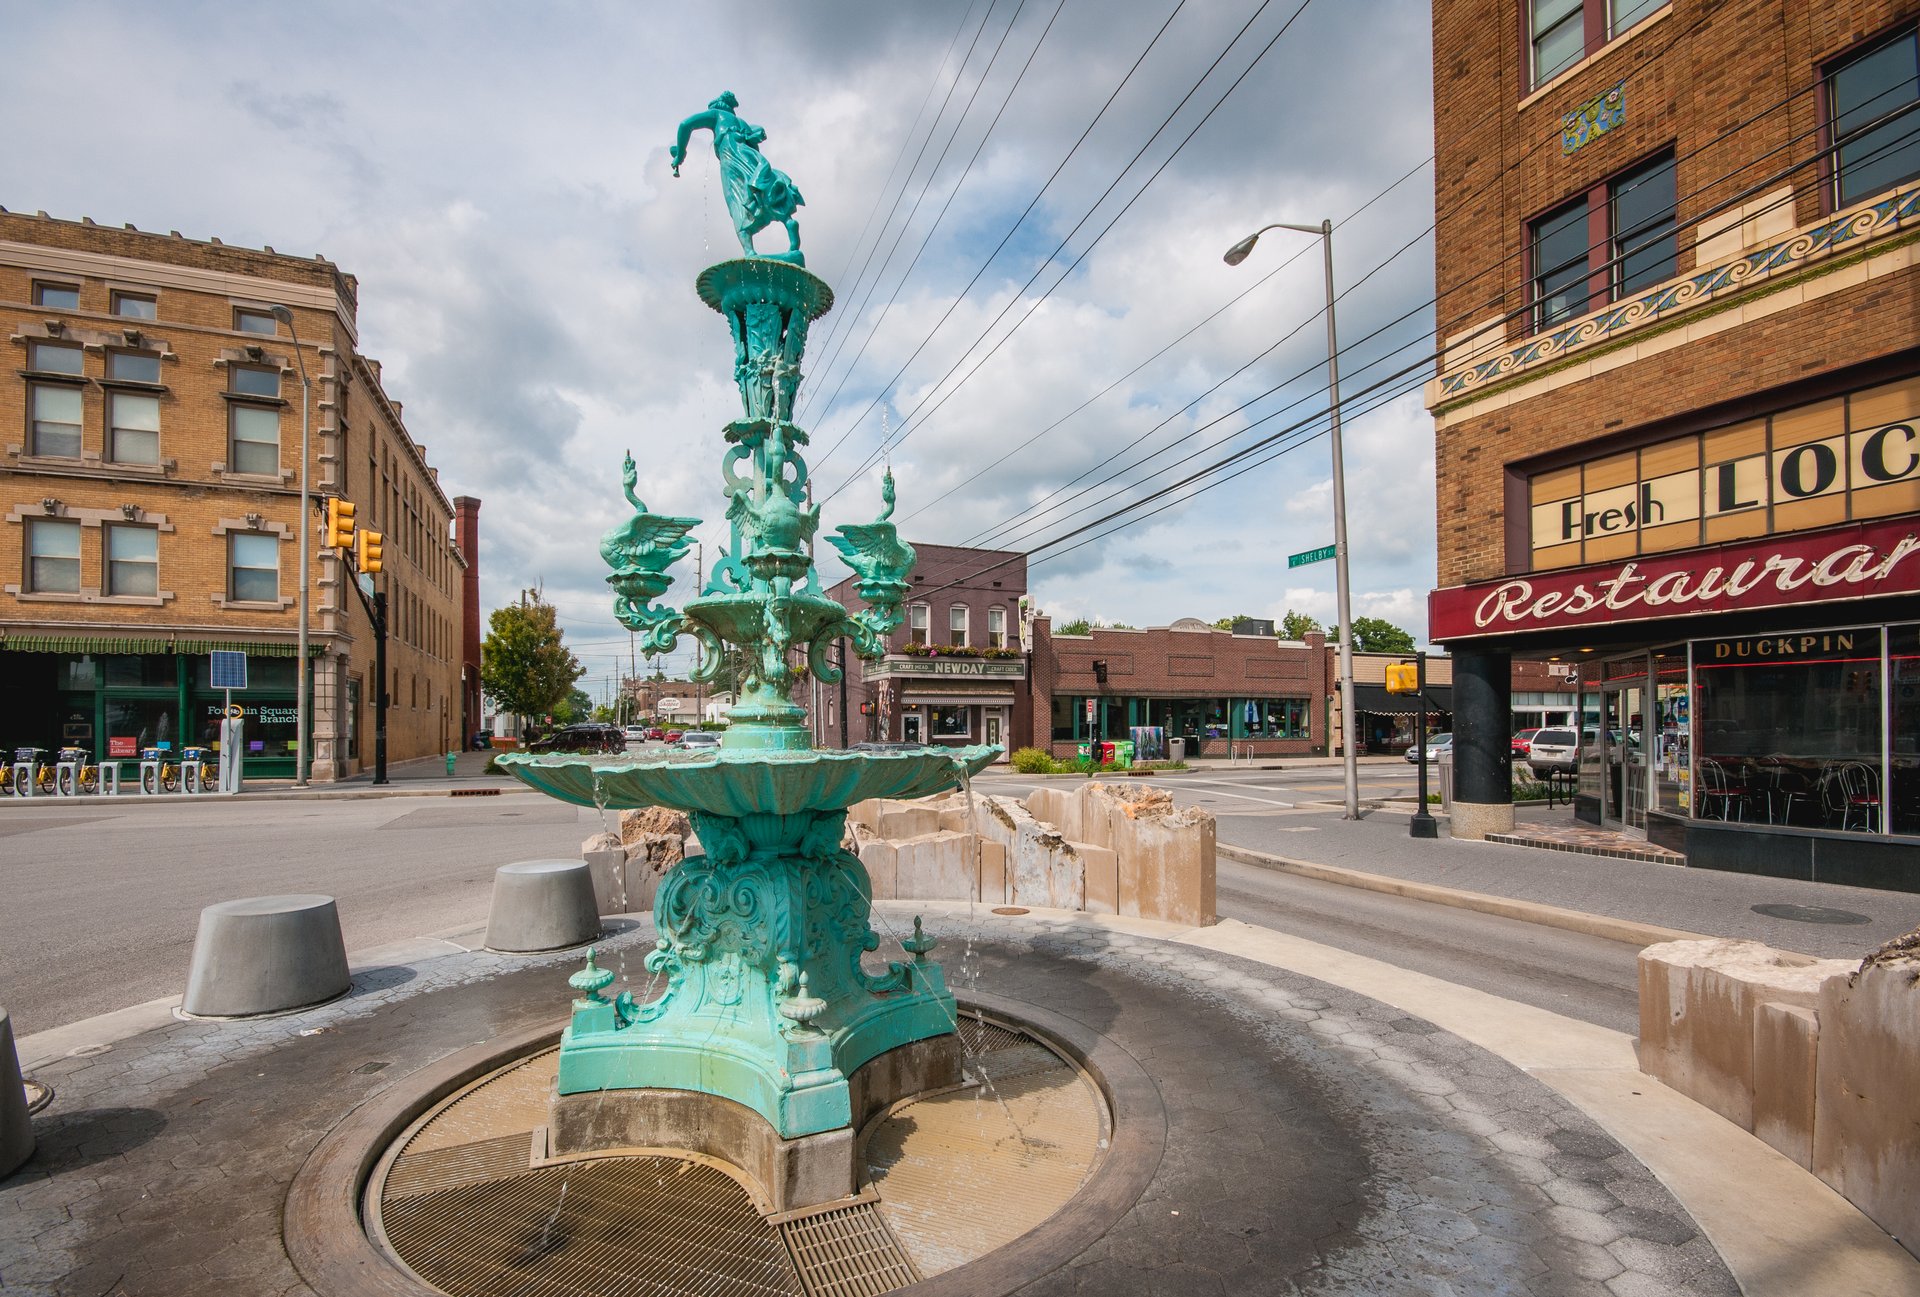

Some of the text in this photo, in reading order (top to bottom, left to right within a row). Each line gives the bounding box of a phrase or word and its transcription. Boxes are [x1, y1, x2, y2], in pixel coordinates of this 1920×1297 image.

[1562, 424, 1920, 540] Fresh LOC
[1301, 549, 1327, 564] SHELBY
[1715, 633, 1854, 658] DUCKPIN
[934, 662, 985, 674] NEWDAY
[207, 706, 258, 715] Fouin
[260, 706, 299, 716] Square
[260, 715, 299, 724] Branch
